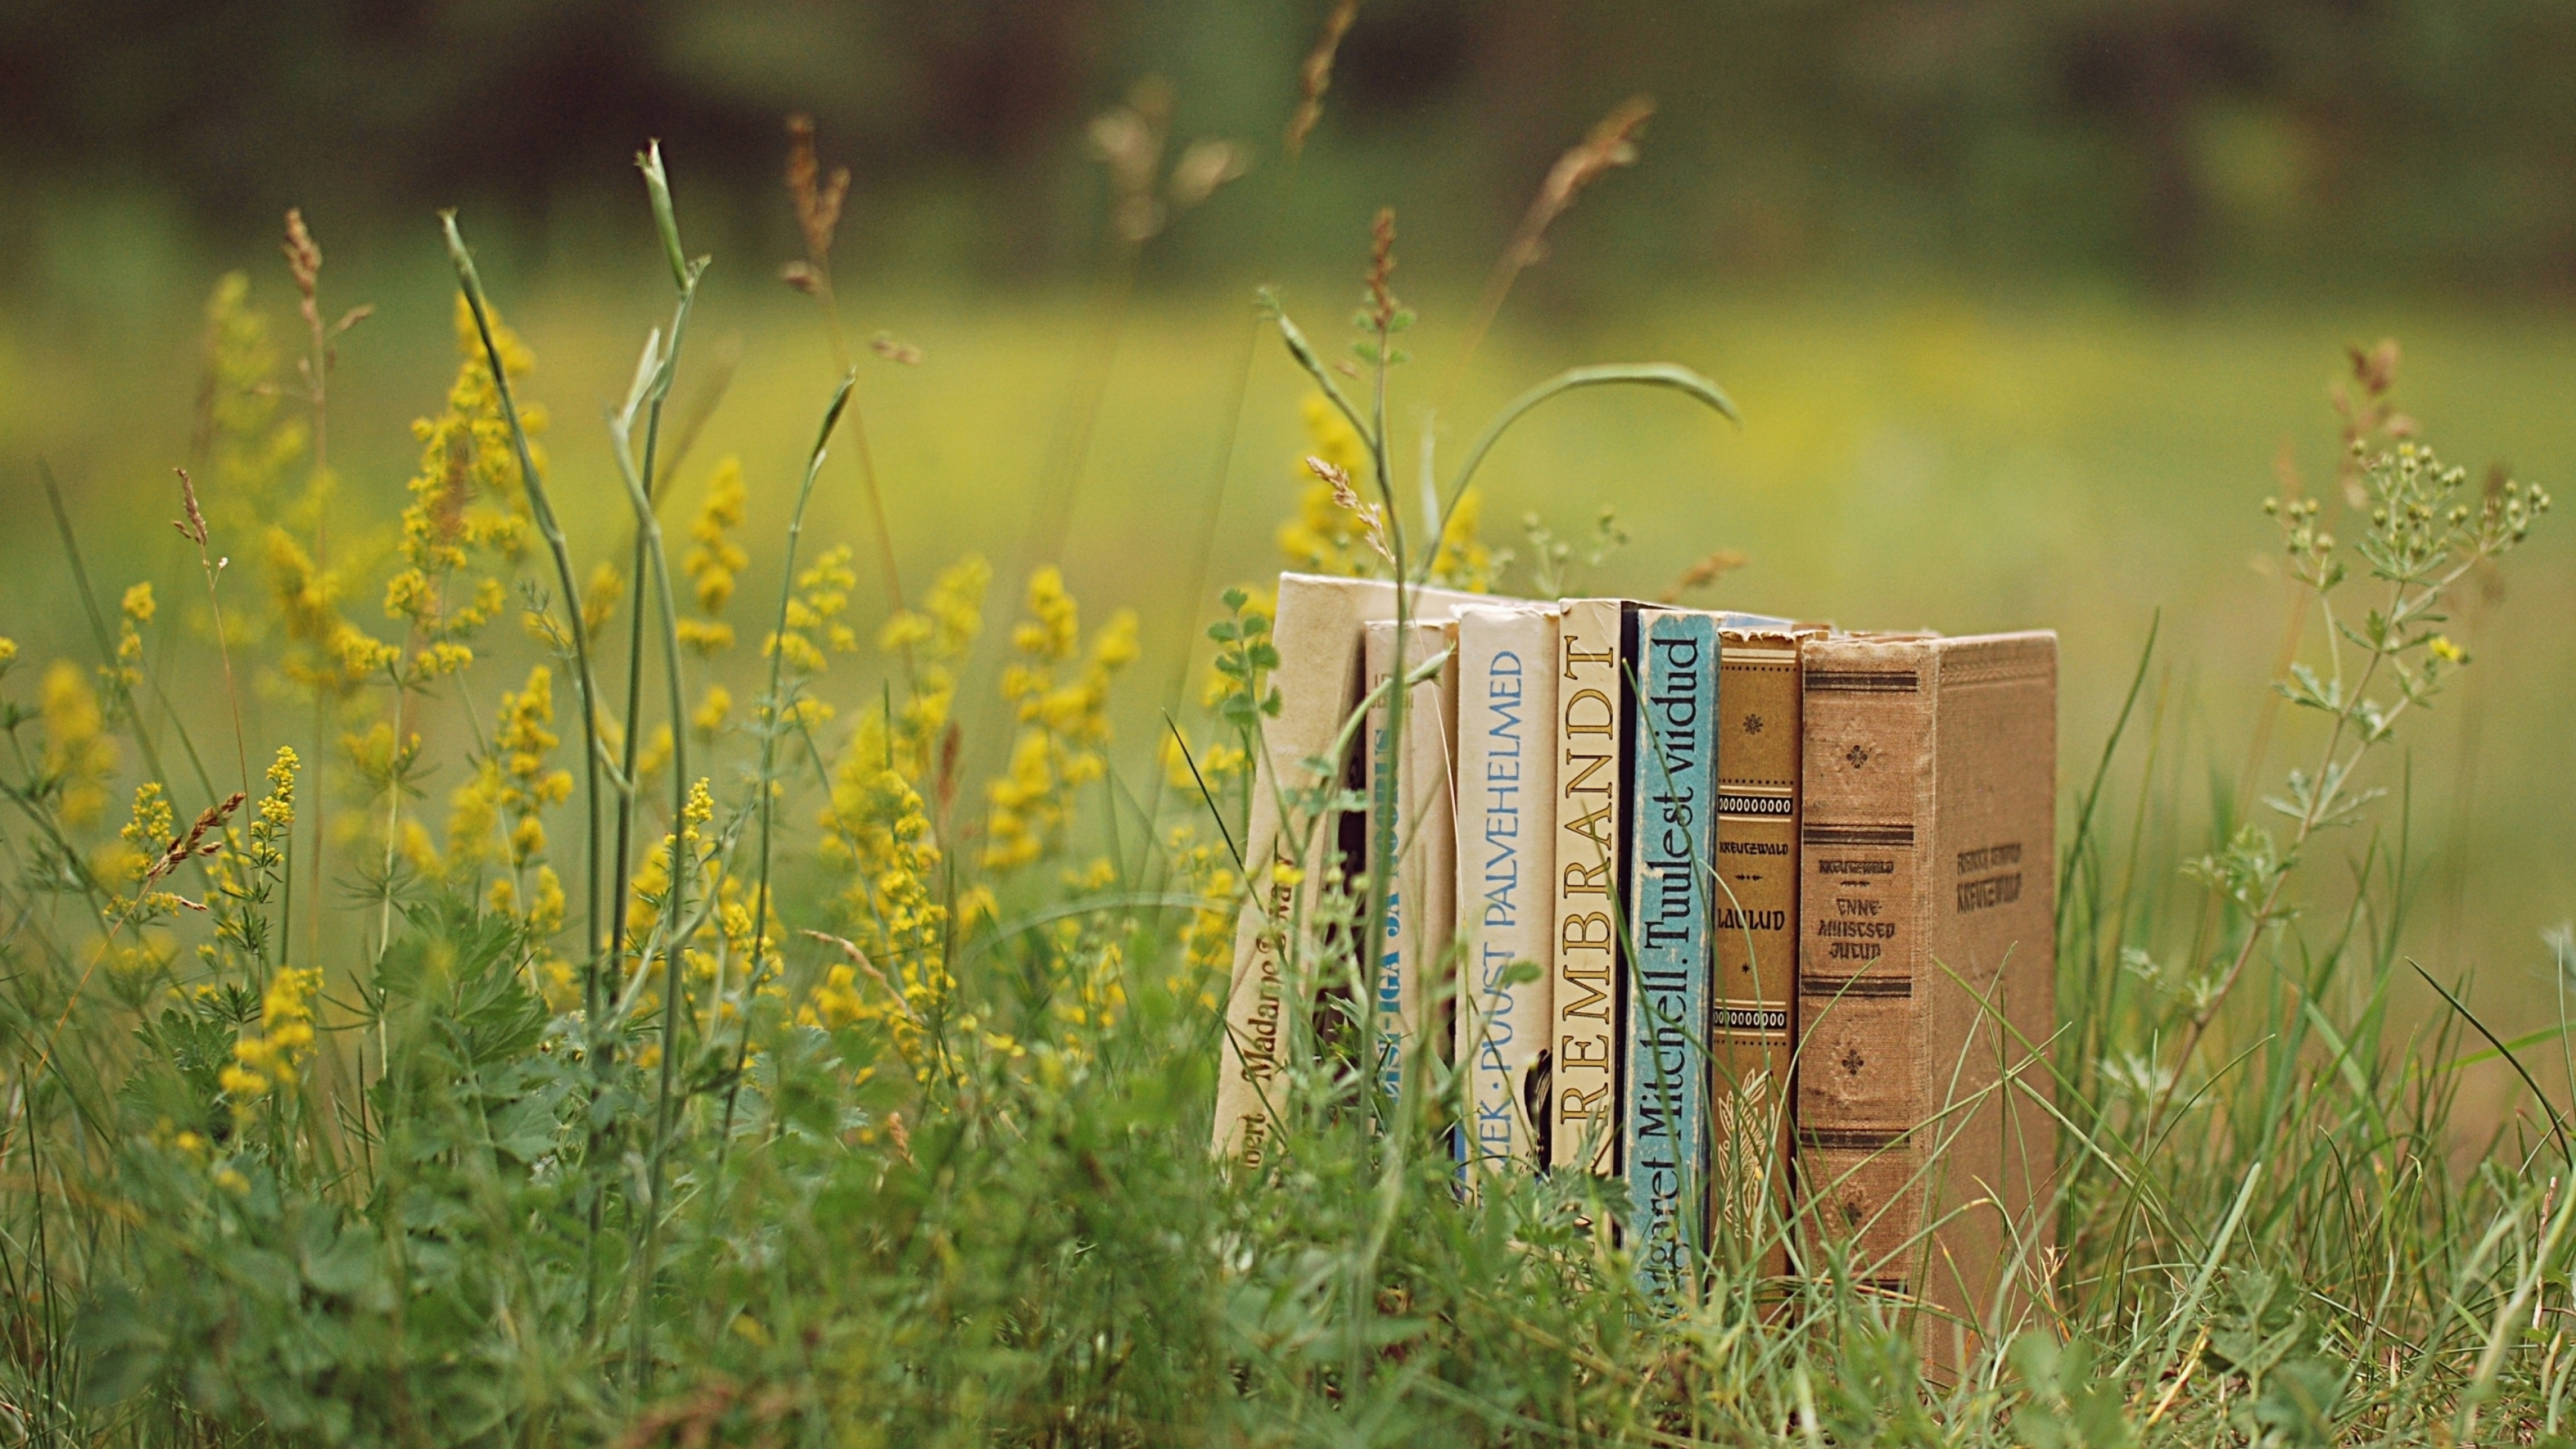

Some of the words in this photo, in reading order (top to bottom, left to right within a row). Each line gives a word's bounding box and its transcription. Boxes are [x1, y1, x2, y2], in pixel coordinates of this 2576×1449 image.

[1483, 650, 1523, 926] PALVEHELMED
[1719, 841, 1789, 856] KREUTZWALD
[1560, 635, 1614, 1126] REMBRANDT
[1644, 786, 1695, 949] Tuulest
[1717, 908, 1786, 931] LAULUD
[1481, 941, 1515, 1071] PUUST
